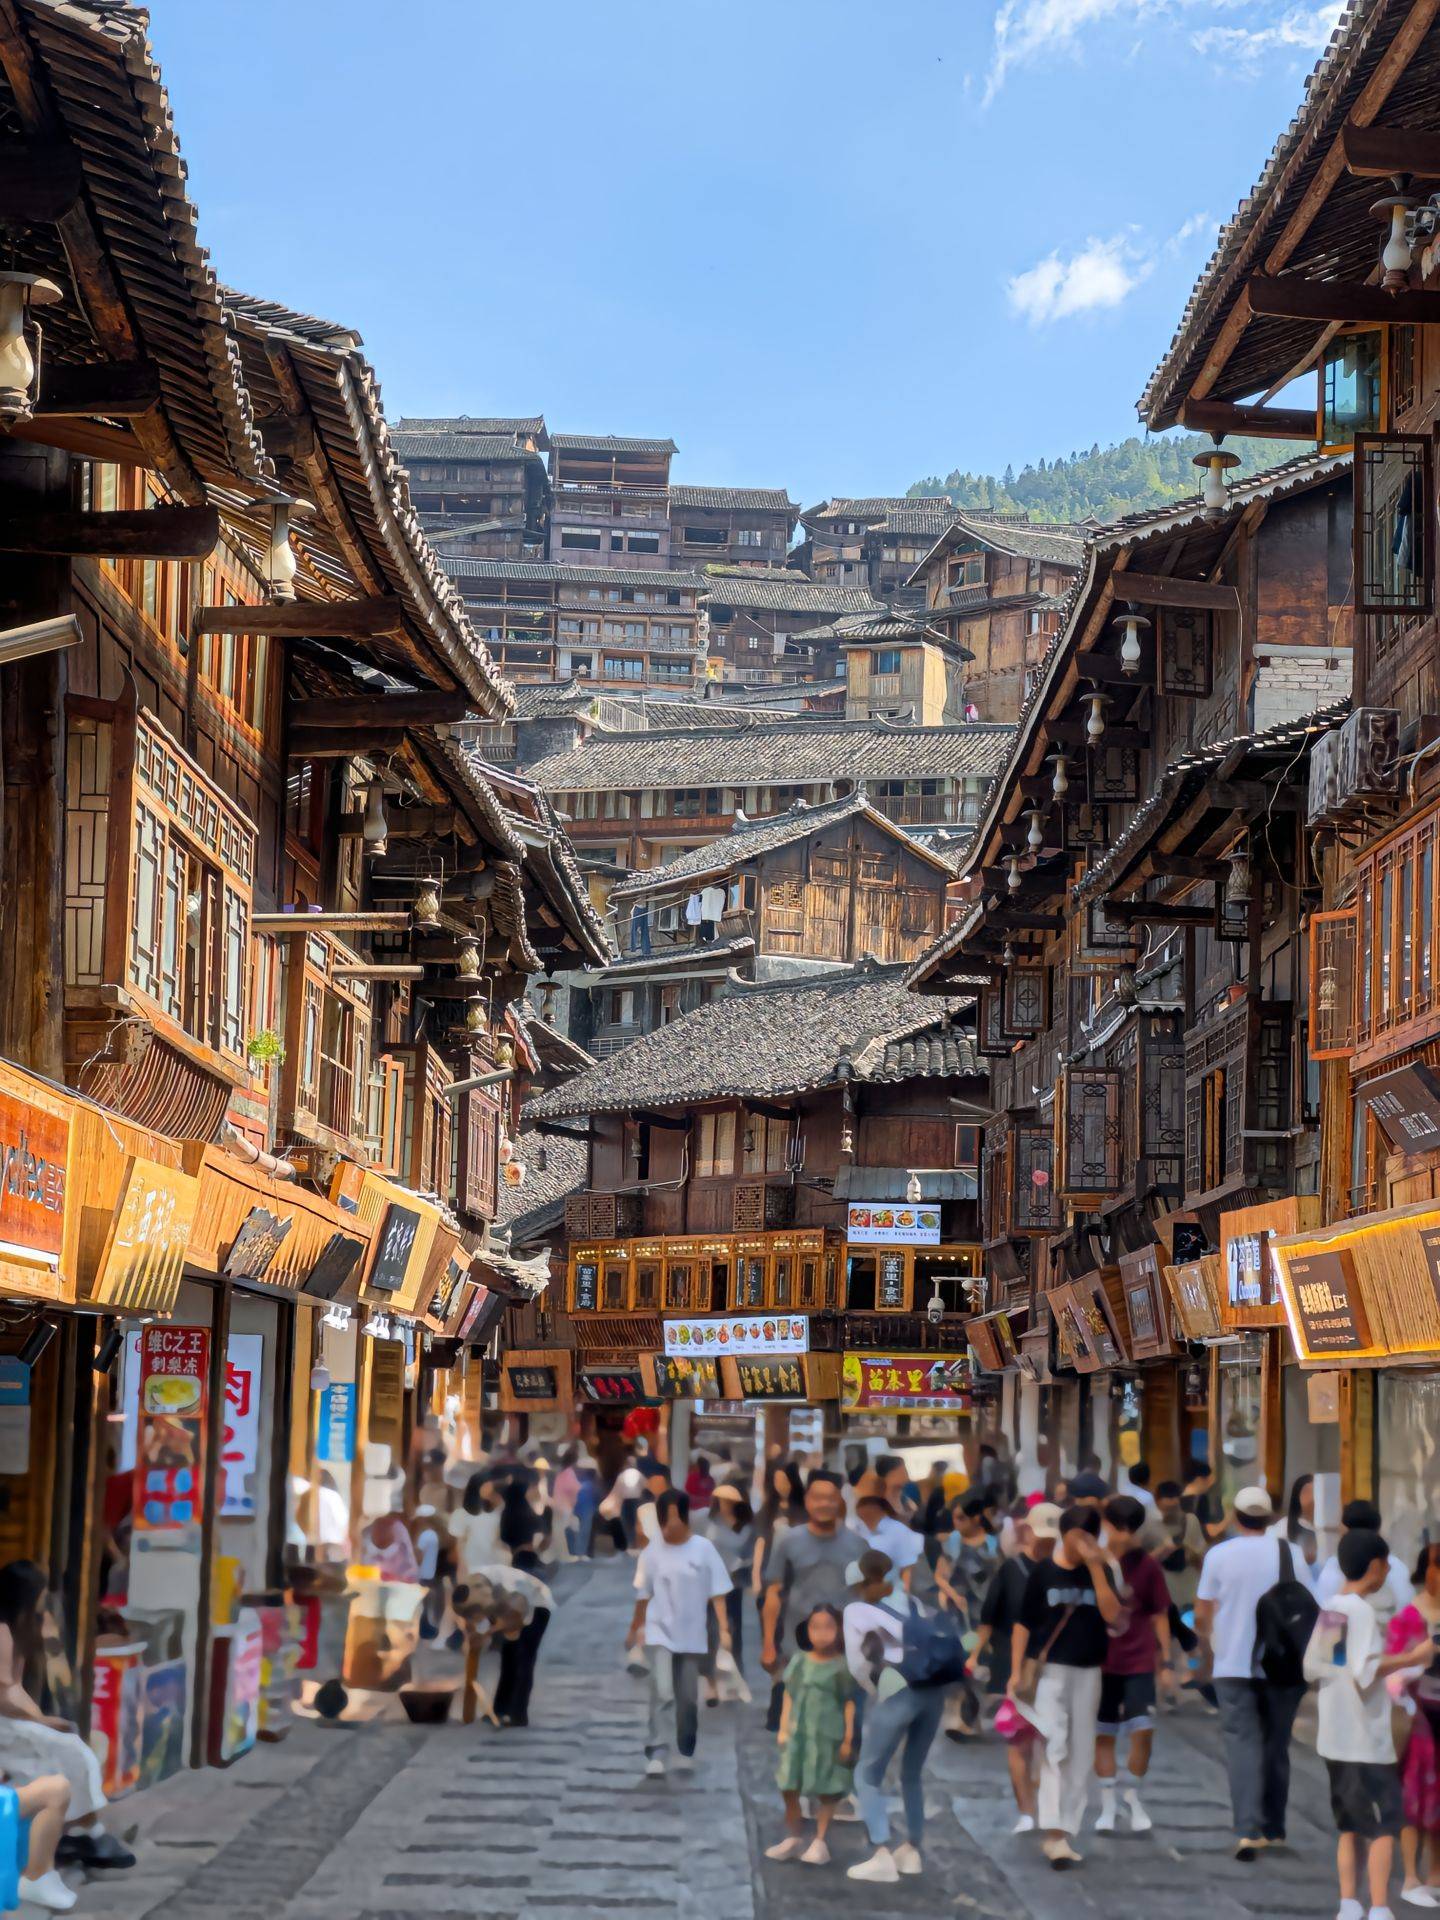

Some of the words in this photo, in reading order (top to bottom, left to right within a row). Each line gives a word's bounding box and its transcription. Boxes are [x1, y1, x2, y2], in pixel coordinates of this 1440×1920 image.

[148, 1330, 201, 1354] 维C之王
[151, 1356, 198, 1374] 刺梨冻
